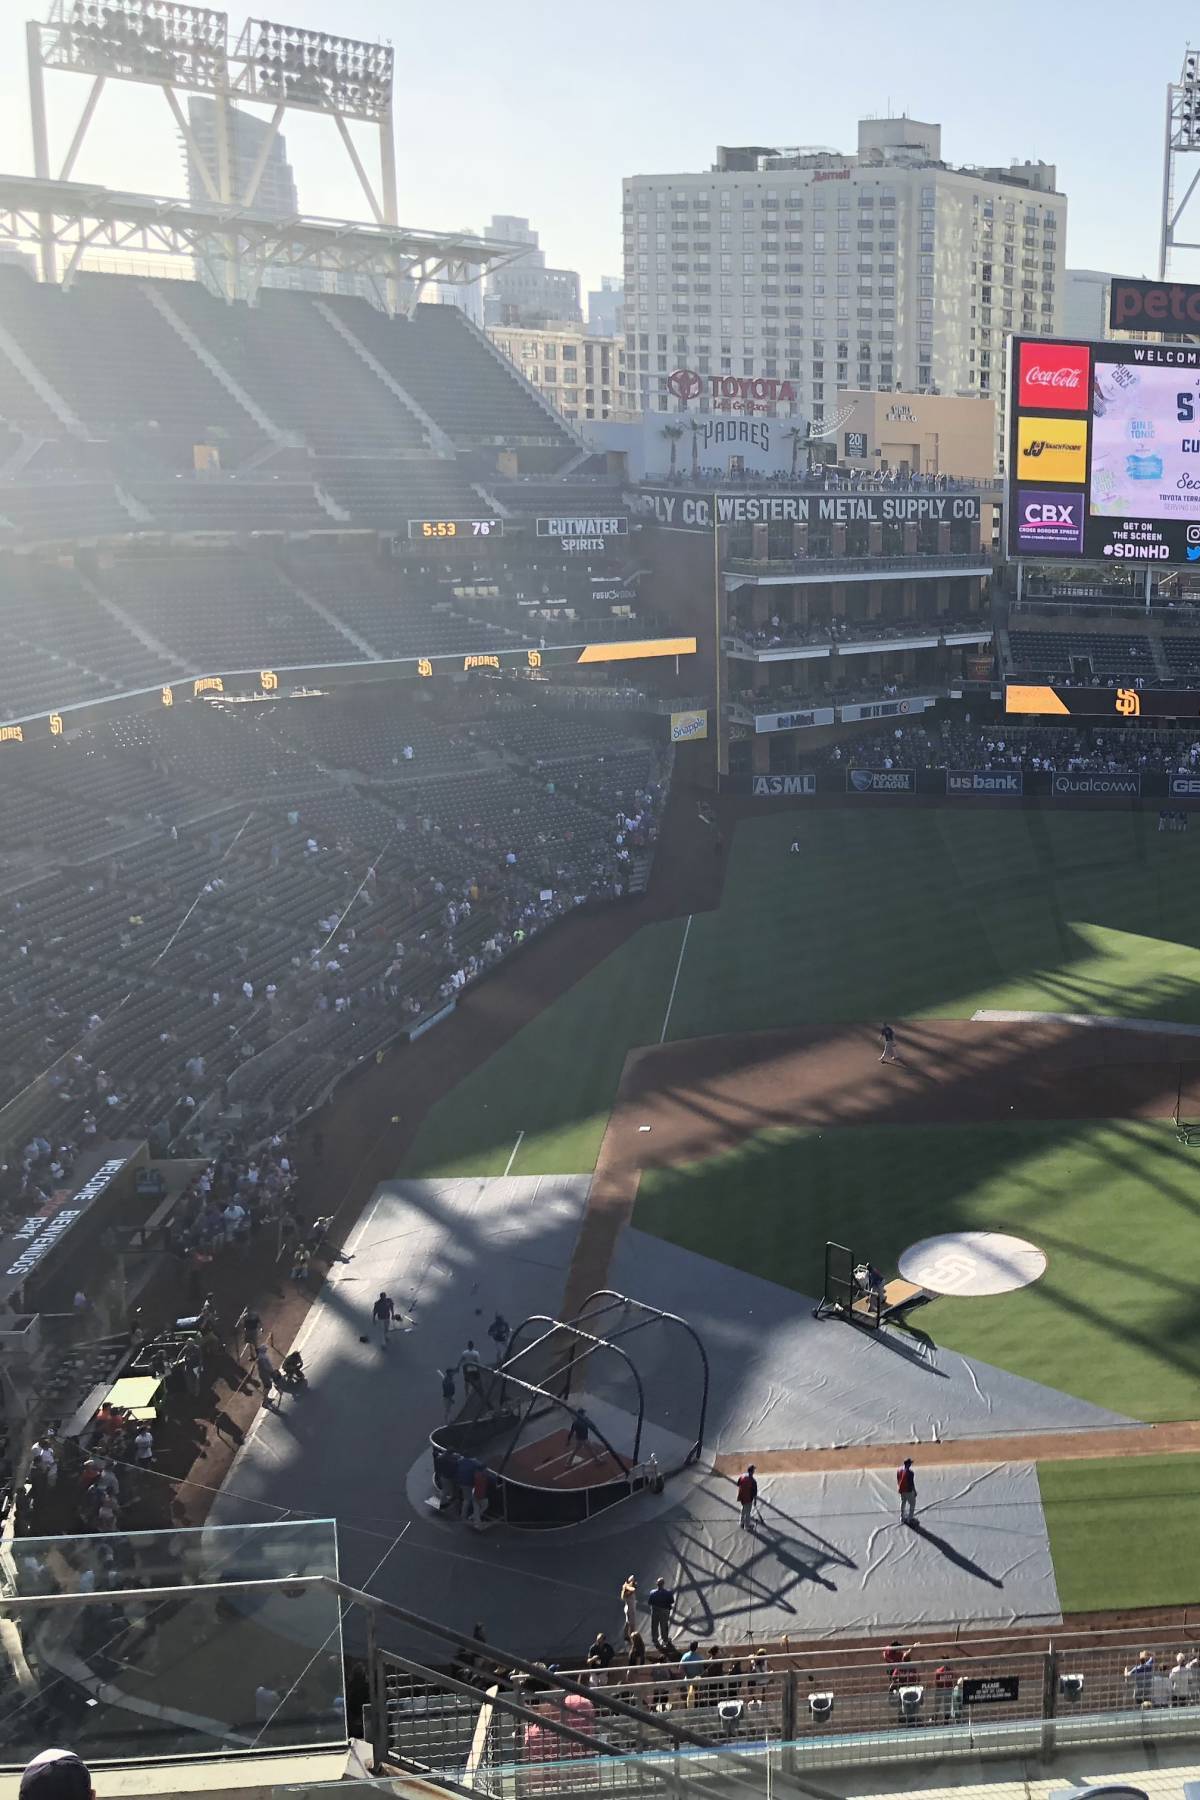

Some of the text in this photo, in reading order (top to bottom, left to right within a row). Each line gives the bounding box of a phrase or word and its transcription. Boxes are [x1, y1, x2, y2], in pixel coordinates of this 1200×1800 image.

[1026, 366, 1081, 388] Coca-Cola
[708, 376, 796, 401] TOYOTA
[704, 421, 769, 452] PADRES
[1159, 494, 1181, 502] TOYOTA
[718, 499, 979, 520] WESTERN METAL SUPPLY CO.
[1025, 504, 1074, 524] CBX
[423, 520, 496, 536] 5:53 76°
[549, 519, 619, 534] CUTWATER
[1123, 522, 1152, 531] GET ON
[562, 538, 604, 551] SPIRITS
[1112, 531, 1162, 541] THE SCREEN
[464, 656, 500, 670] PADRES
[194, 678, 223, 697] PADRES
[673, 717, 705, 738] Snapple
[754, 776, 814, 794] ASML
[873, 773, 909, 782] ROCKET
[873, 780, 910, 789] LEAGUE
[1056, 777, 1137, 793] Qualcomm
[73, 1158, 128, 1200] WELCOME
[6, 1210, 81, 1275] BIENVENIDOS
